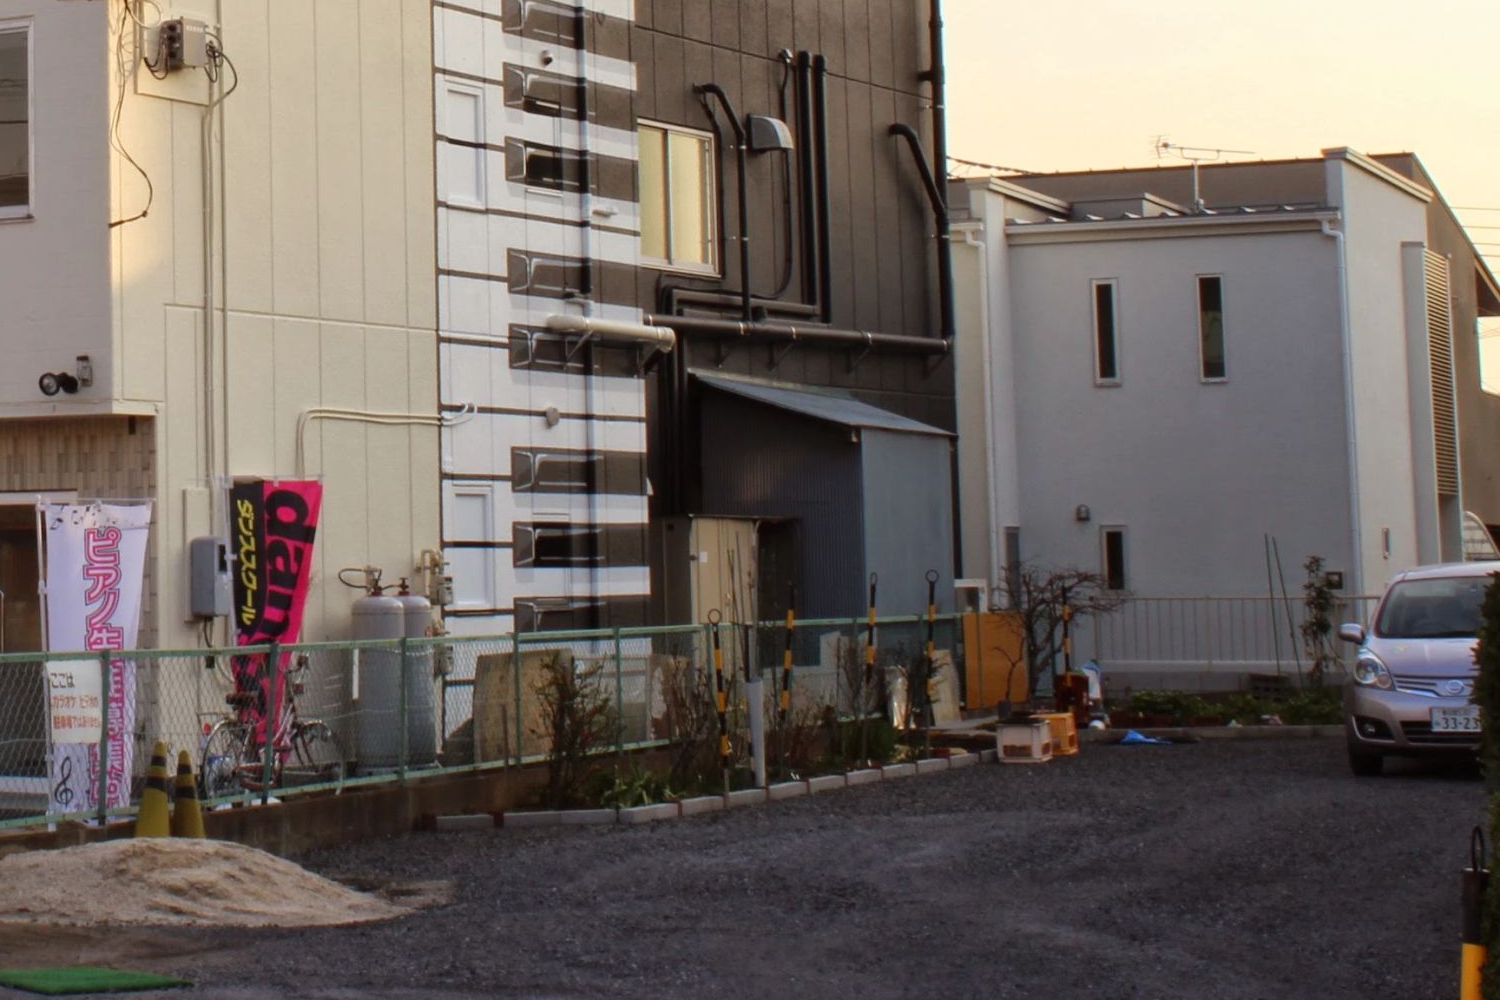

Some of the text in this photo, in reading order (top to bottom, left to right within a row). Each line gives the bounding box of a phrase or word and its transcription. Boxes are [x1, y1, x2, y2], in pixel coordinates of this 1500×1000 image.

[237, 500, 257, 625] ダンススクール
[51, 672, 75, 688] ここは
